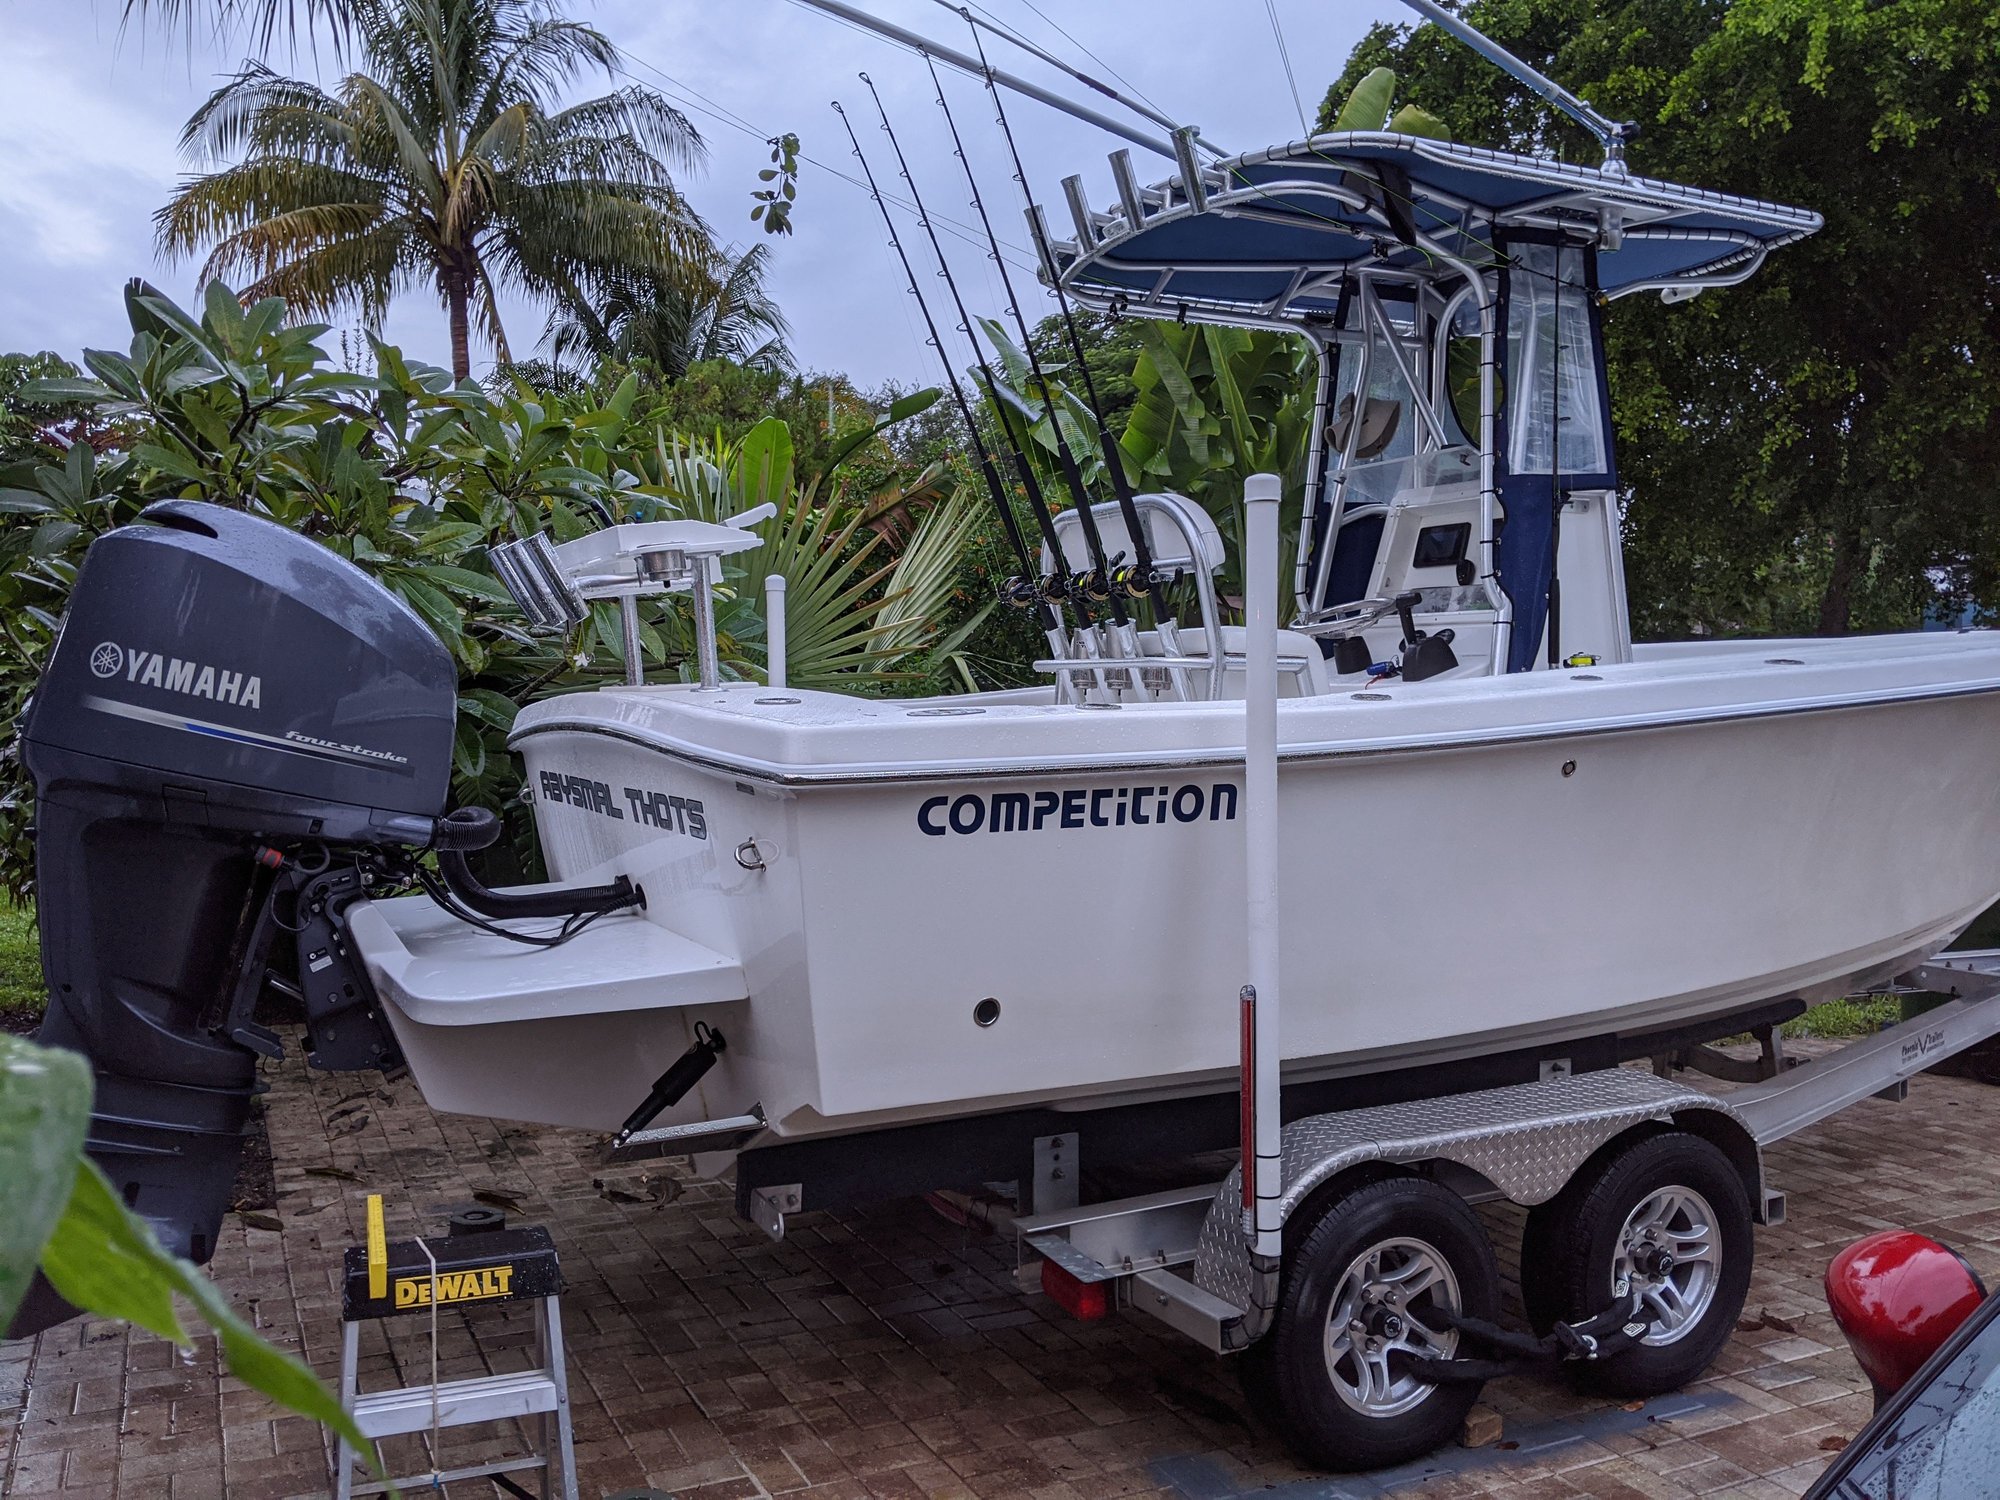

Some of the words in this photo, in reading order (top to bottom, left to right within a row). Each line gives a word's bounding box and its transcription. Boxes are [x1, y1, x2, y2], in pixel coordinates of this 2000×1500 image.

[127, 648, 261, 709] YAMAHA
[285, 730, 338, 748] four
[340, 744, 408, 764] stroke
[539, 770, 625, 820] ABYSMAL
[623, 787, 707, 841] THOTS
[917, 783, 1238, 836] COMPETITION
